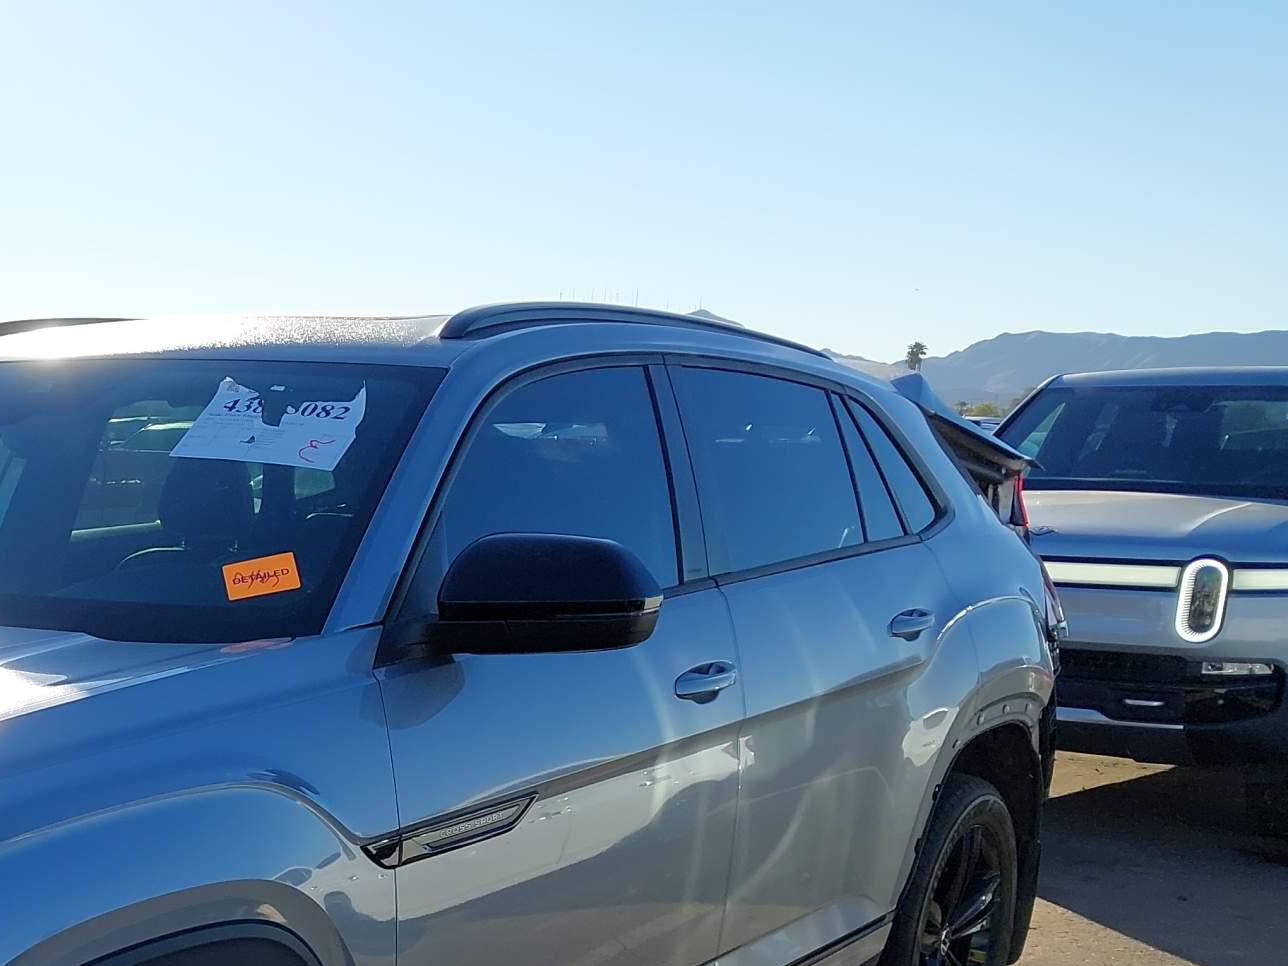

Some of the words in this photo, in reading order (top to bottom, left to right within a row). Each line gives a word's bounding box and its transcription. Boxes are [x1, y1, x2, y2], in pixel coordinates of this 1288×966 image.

[232, 568, 290, 585] DETAILED
[440, 823, 471, 838] CROSS
[474, 813, 503, 827] SPORT
